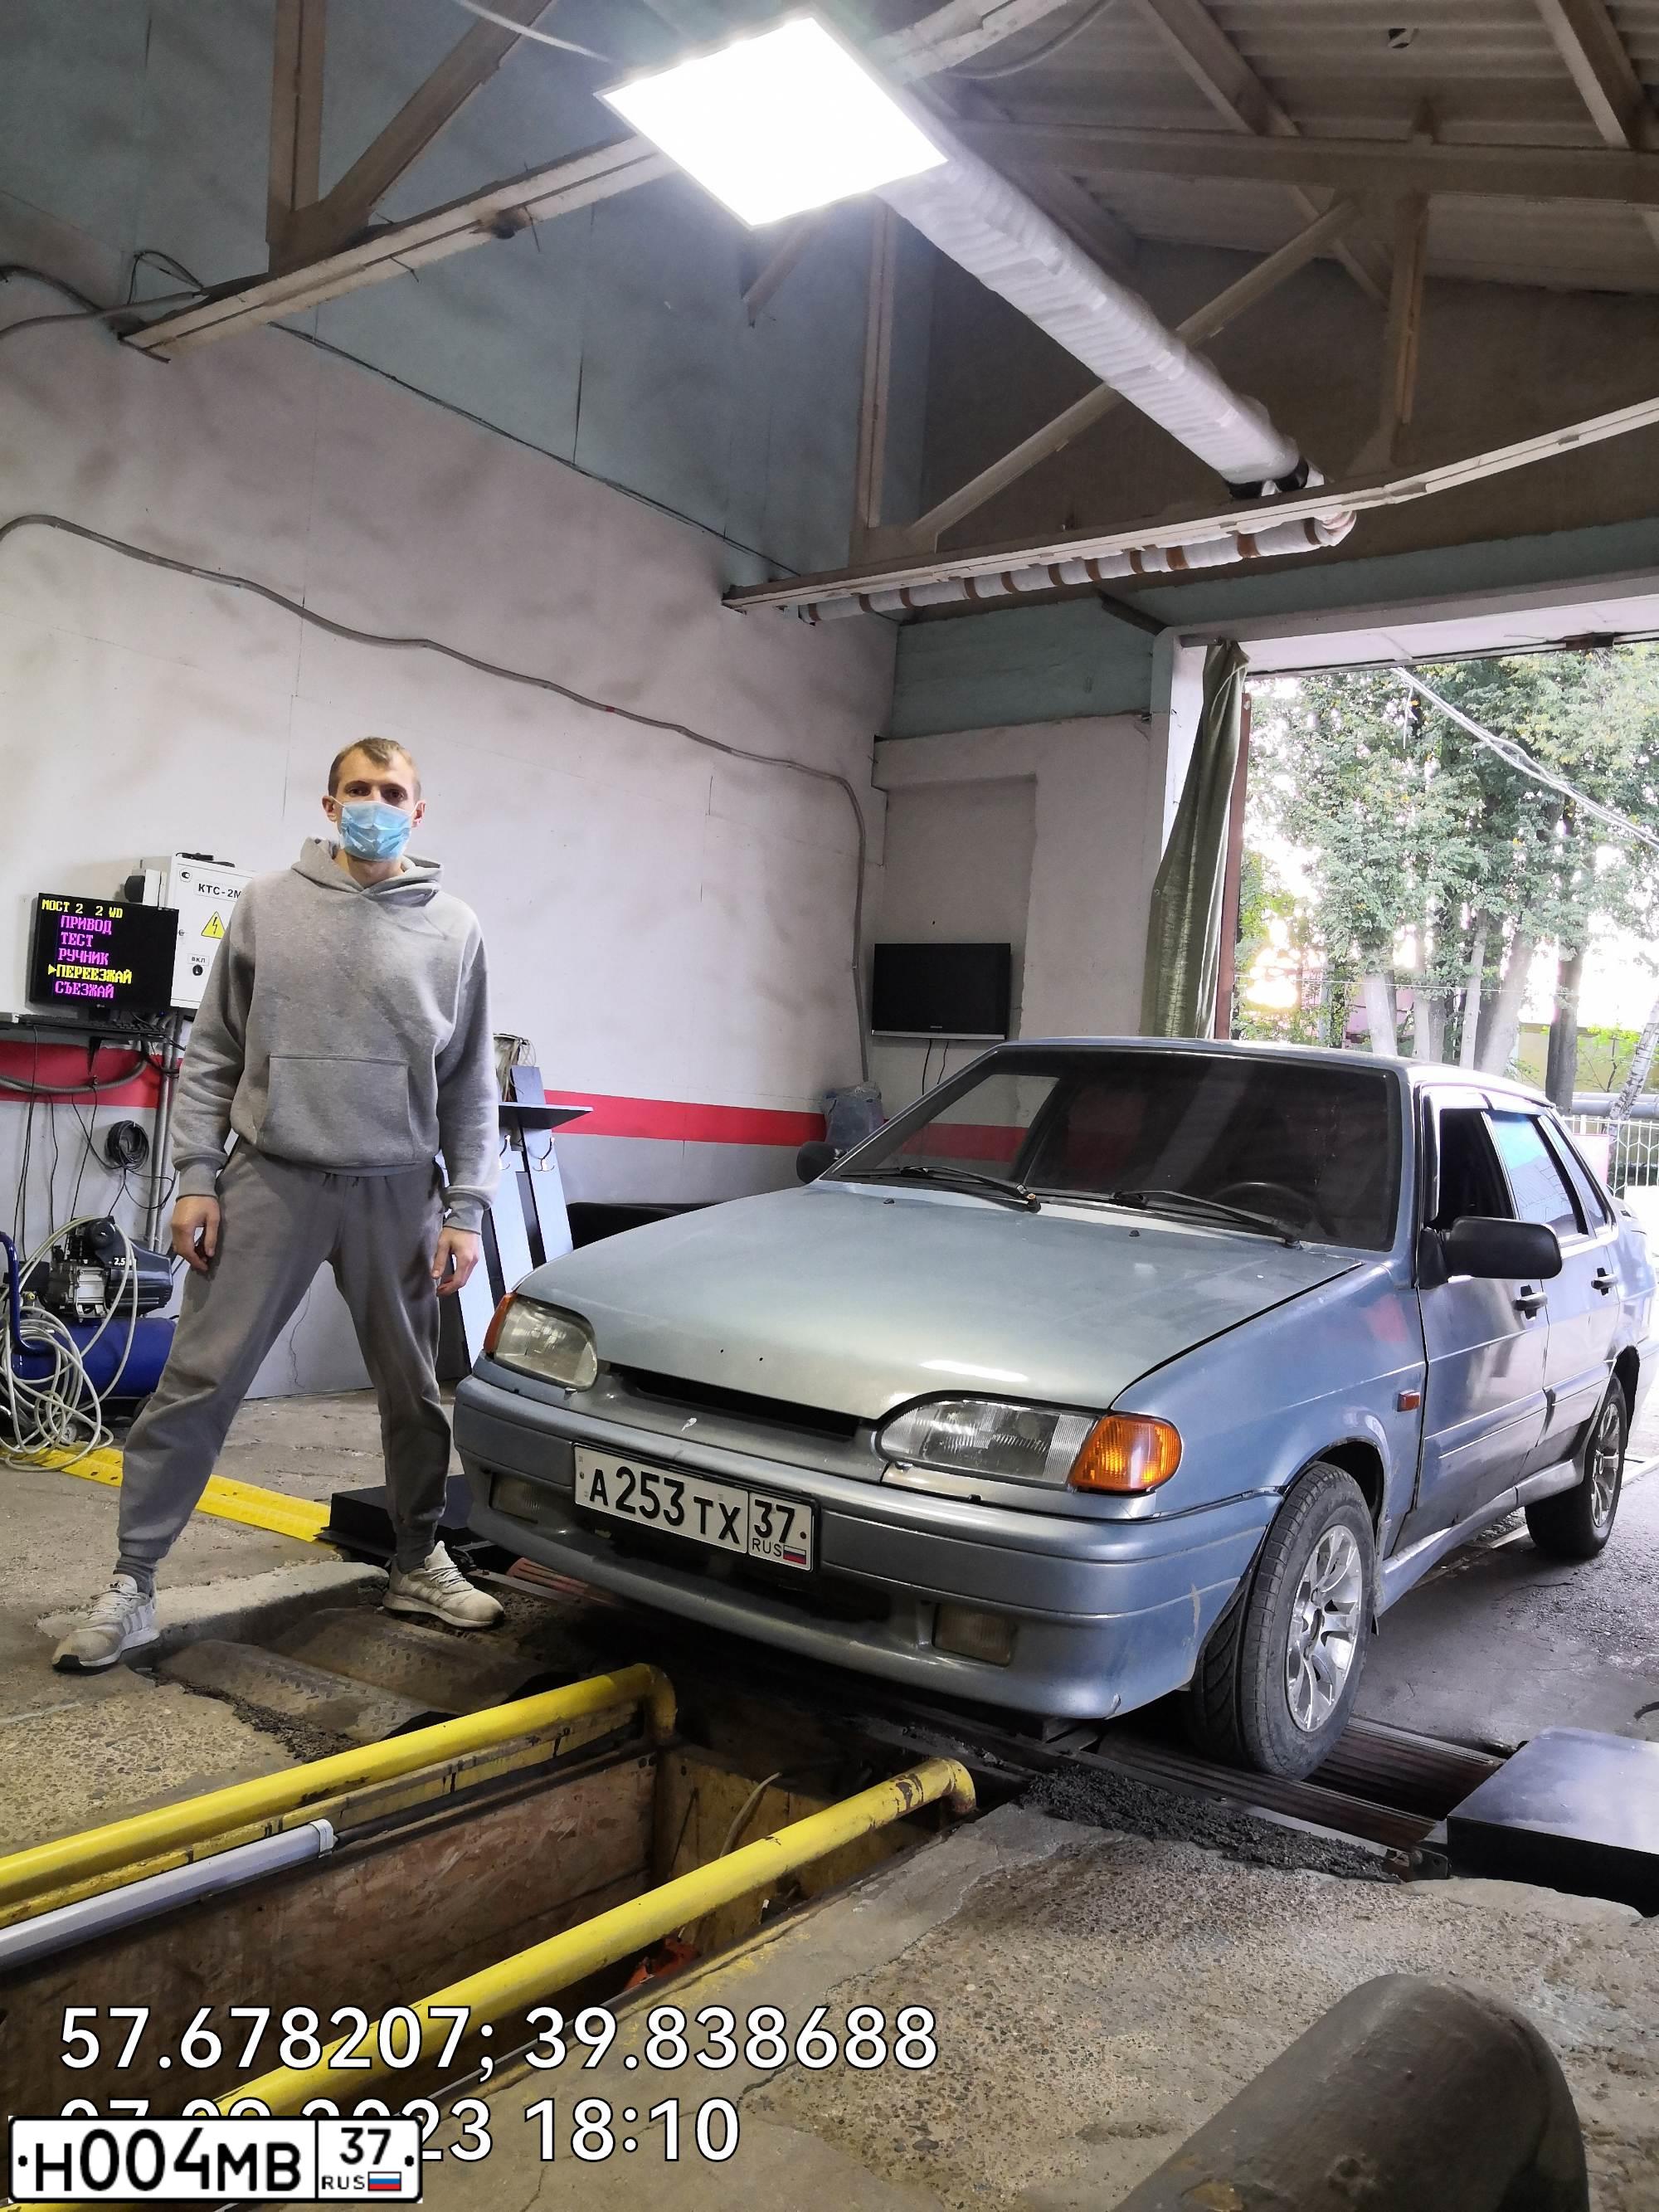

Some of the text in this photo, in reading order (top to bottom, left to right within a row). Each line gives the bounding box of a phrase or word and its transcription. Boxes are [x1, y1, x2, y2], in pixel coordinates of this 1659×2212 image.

[41, 899, 124, 918] МОСТ 2 2 WD
[61, 914, 112, 935] ПРИВОД
[61, 932, 94, 948] ТЕСТ
[57, 948, 109, 966] РУЧНИК
[56, 964, 133, 984] ПЕРЕЕЗЖАЙ
[55, 981, 114, 999] СЪЕЗЖАЙ
[589, 1466, 795, 1545] А253ТХ 37
[752, 1537, 782, 1557] RUS
